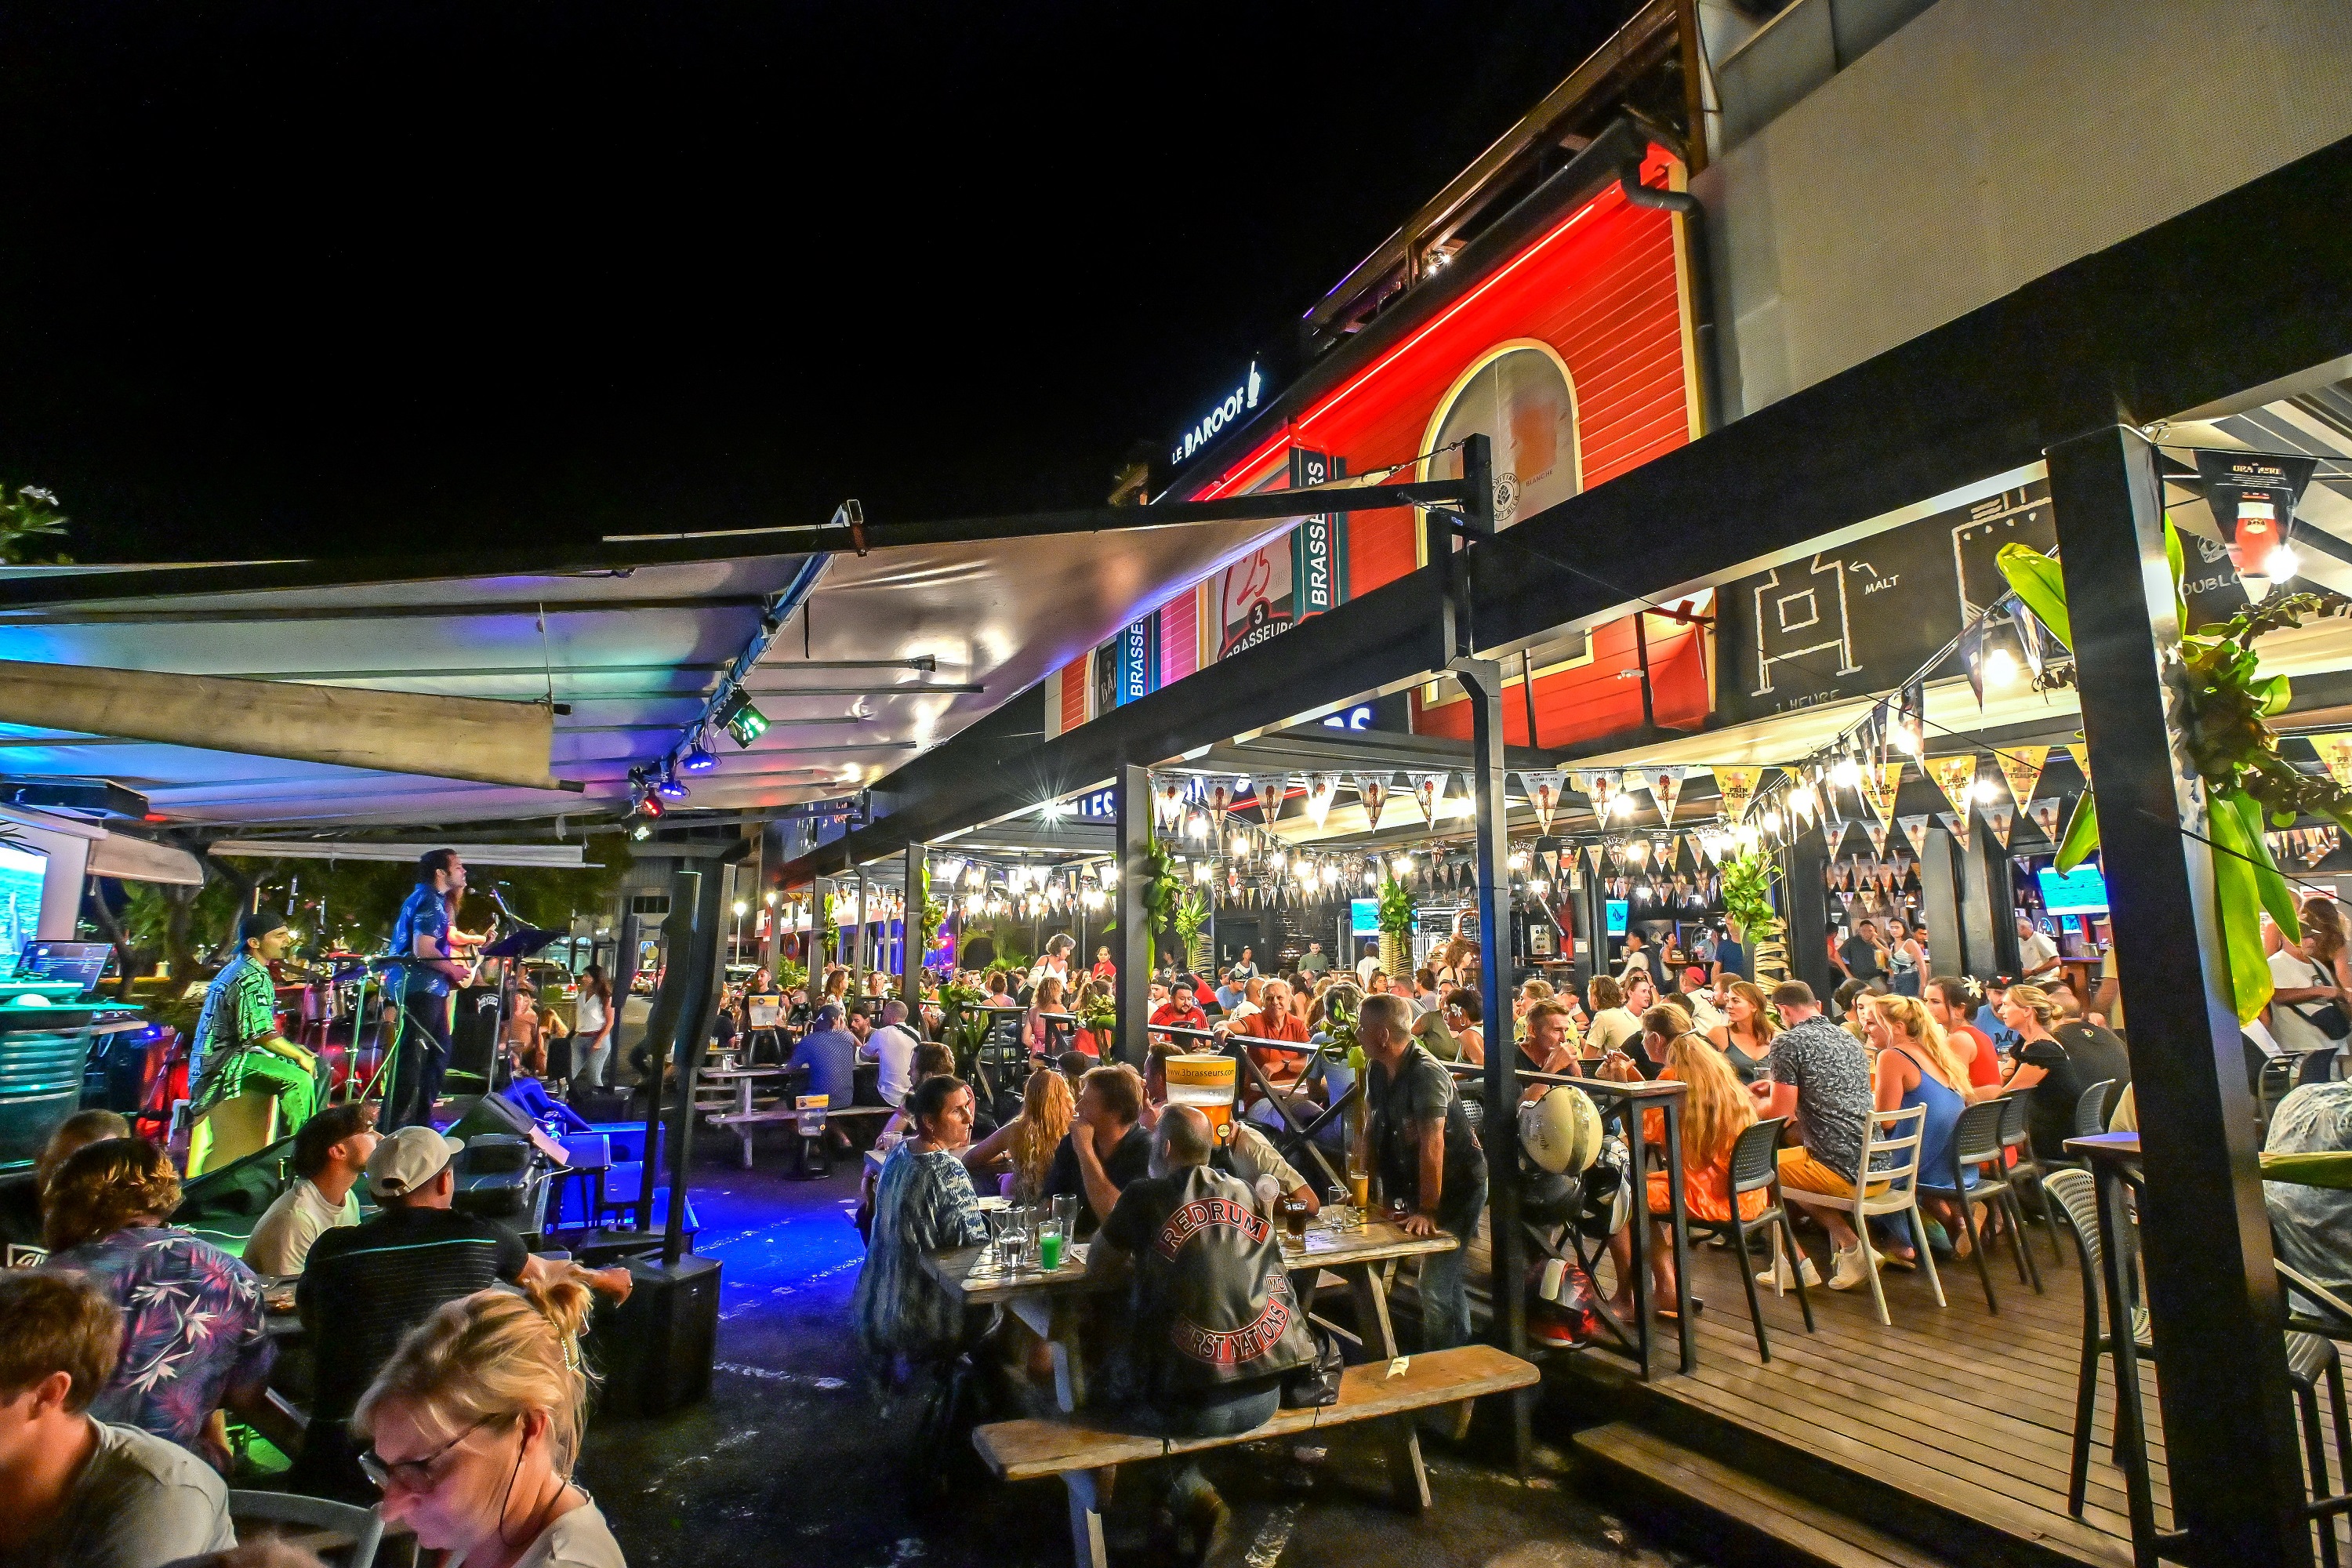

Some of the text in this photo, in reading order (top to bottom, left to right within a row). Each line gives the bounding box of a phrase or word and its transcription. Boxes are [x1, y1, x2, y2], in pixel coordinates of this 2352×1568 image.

[1172, 387, 1243, 465] LE BAROOF
[1526, 468, 1553, 487] BLANCHE
[1306, 462, 1327, 606] BRASSERS
[1865, 575, 1899, 595] MALT
[1254, 604, 1263, 625] 3
[1130, 618, 1144, 697] BRASSE
[1775, 689, 1839, 713] 1 HEURE
[1161, 1201, 1262, 1251] REDRUM
[1268, 1276, 1286, 1293] MC
[1229, 1304, 1287, 1357] NATIONS
